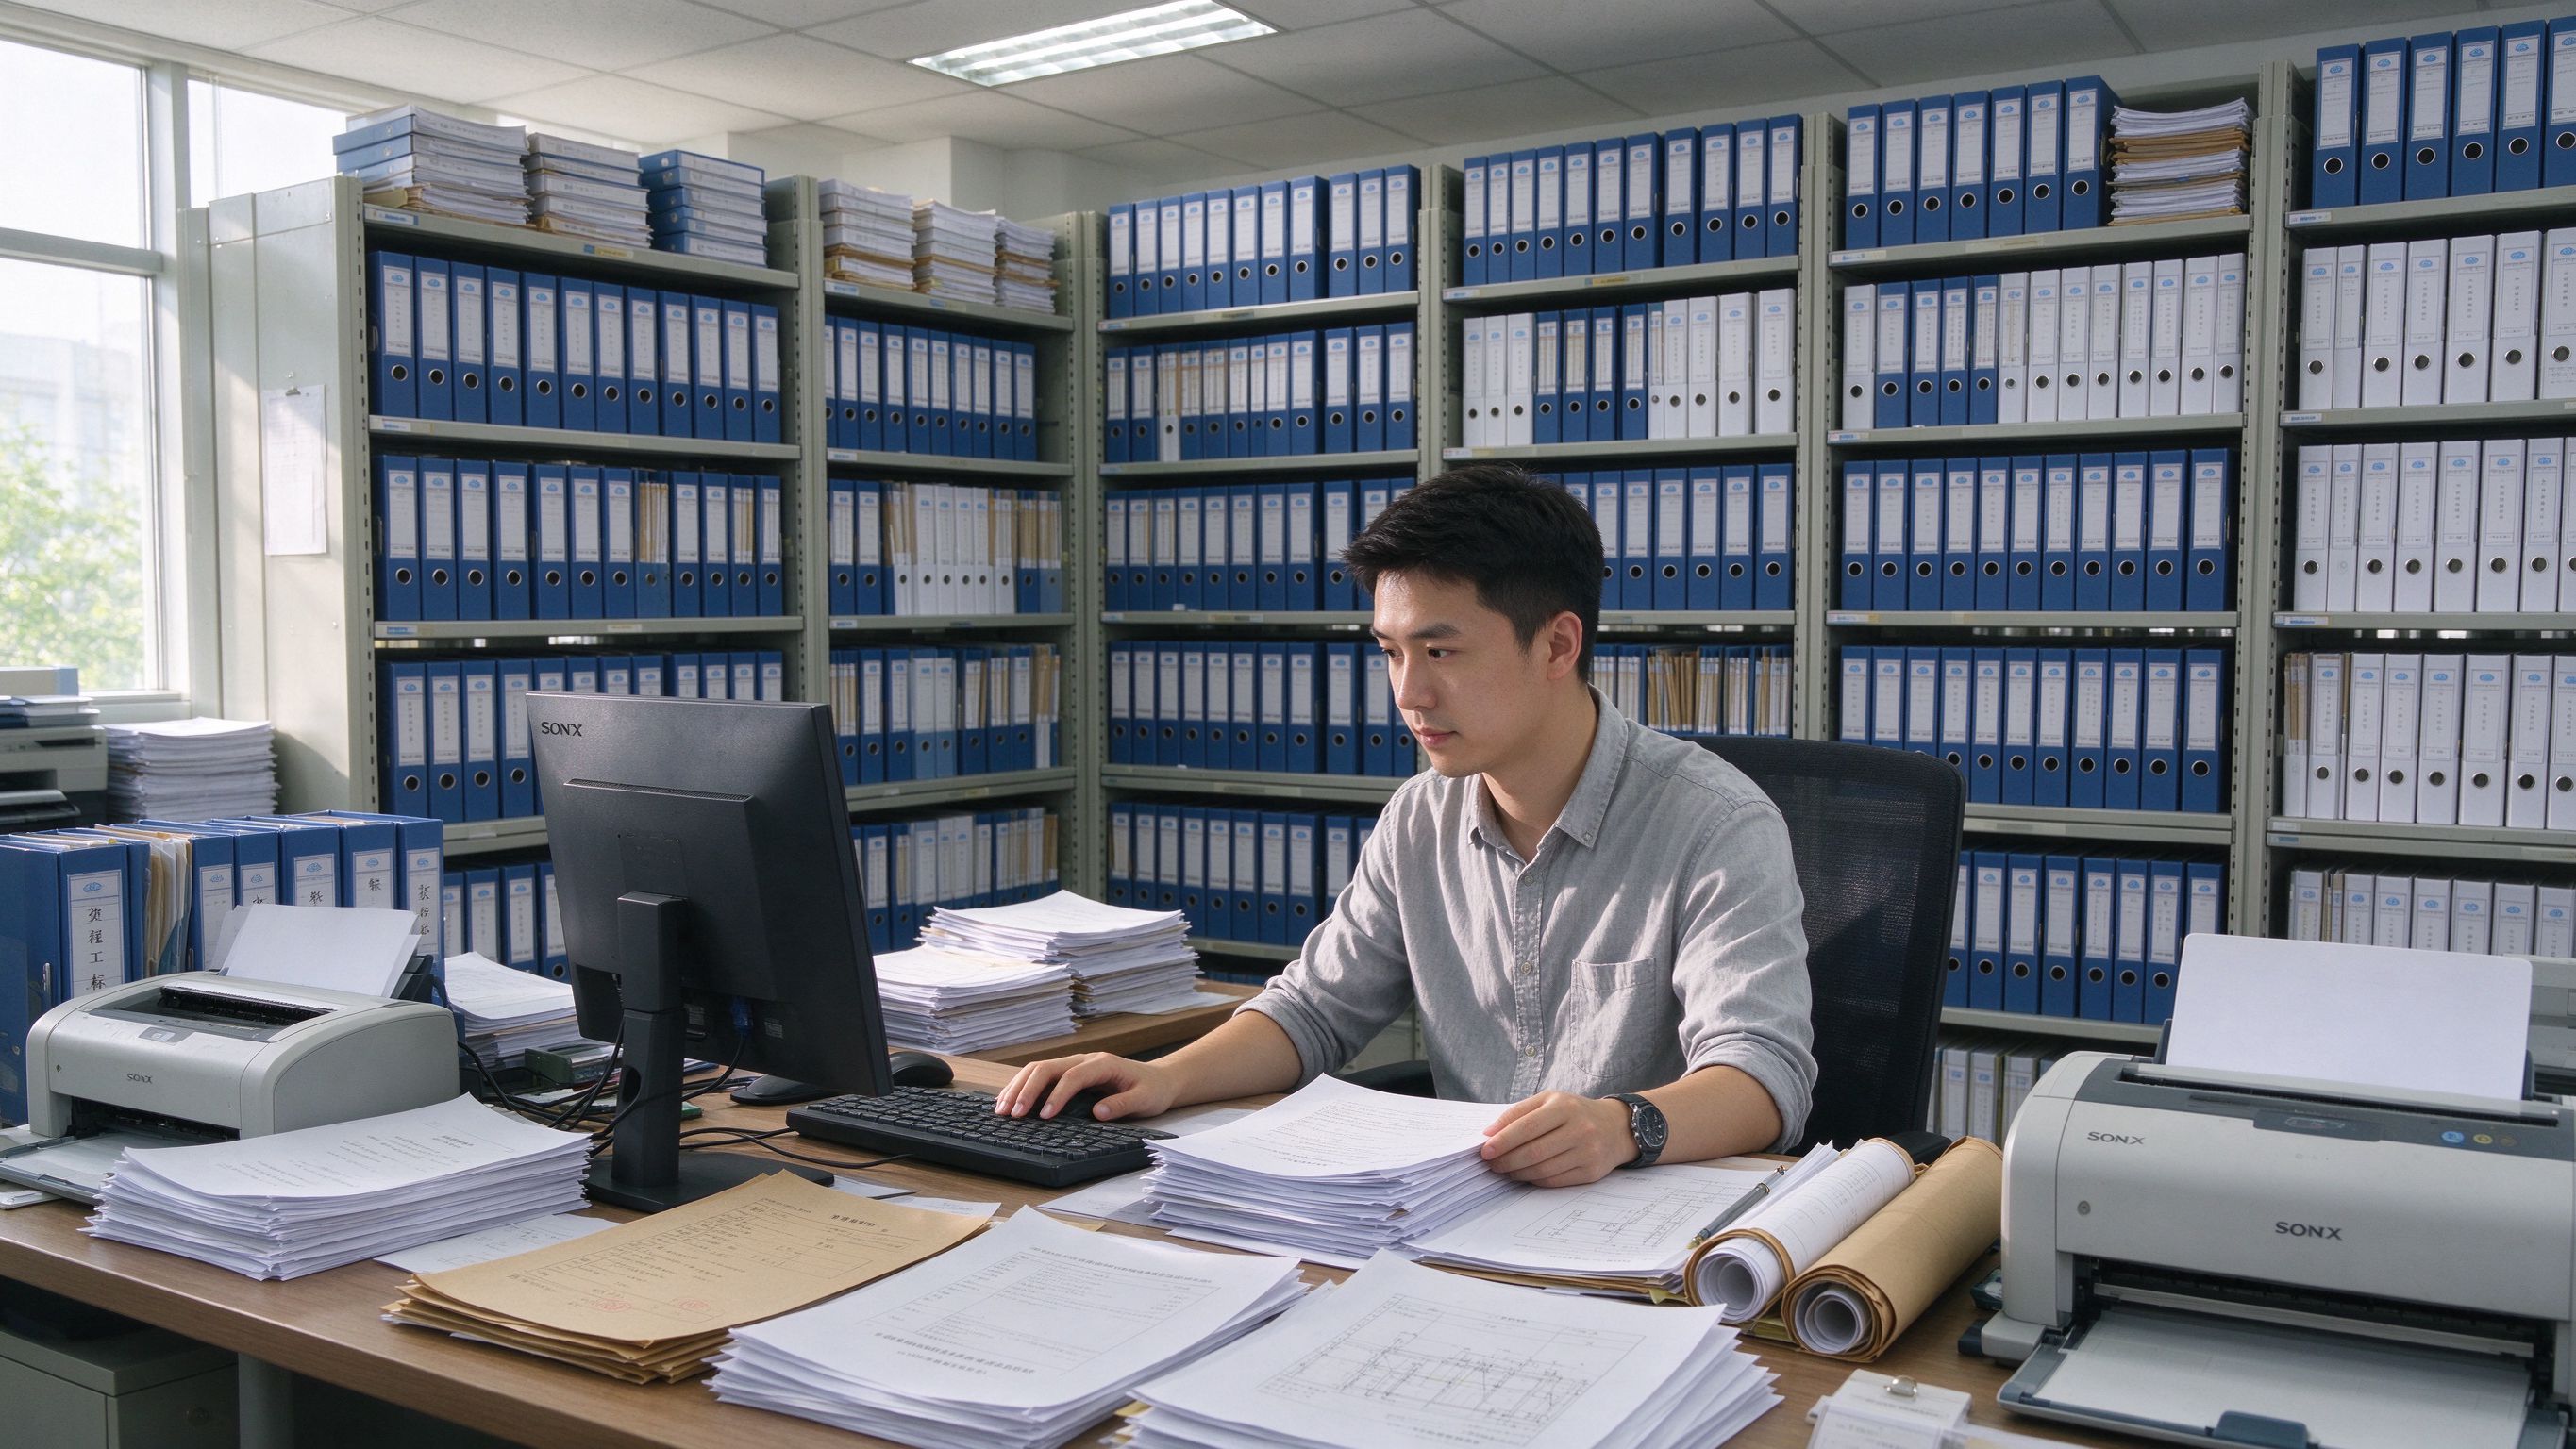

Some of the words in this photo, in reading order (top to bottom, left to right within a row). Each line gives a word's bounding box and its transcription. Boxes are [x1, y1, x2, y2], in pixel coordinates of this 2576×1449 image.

[541, 721, 583, 737] SONX
[2086, 1131, 2146, 1146] SONX
[2275, 1221, 2343, 1241] SONX
